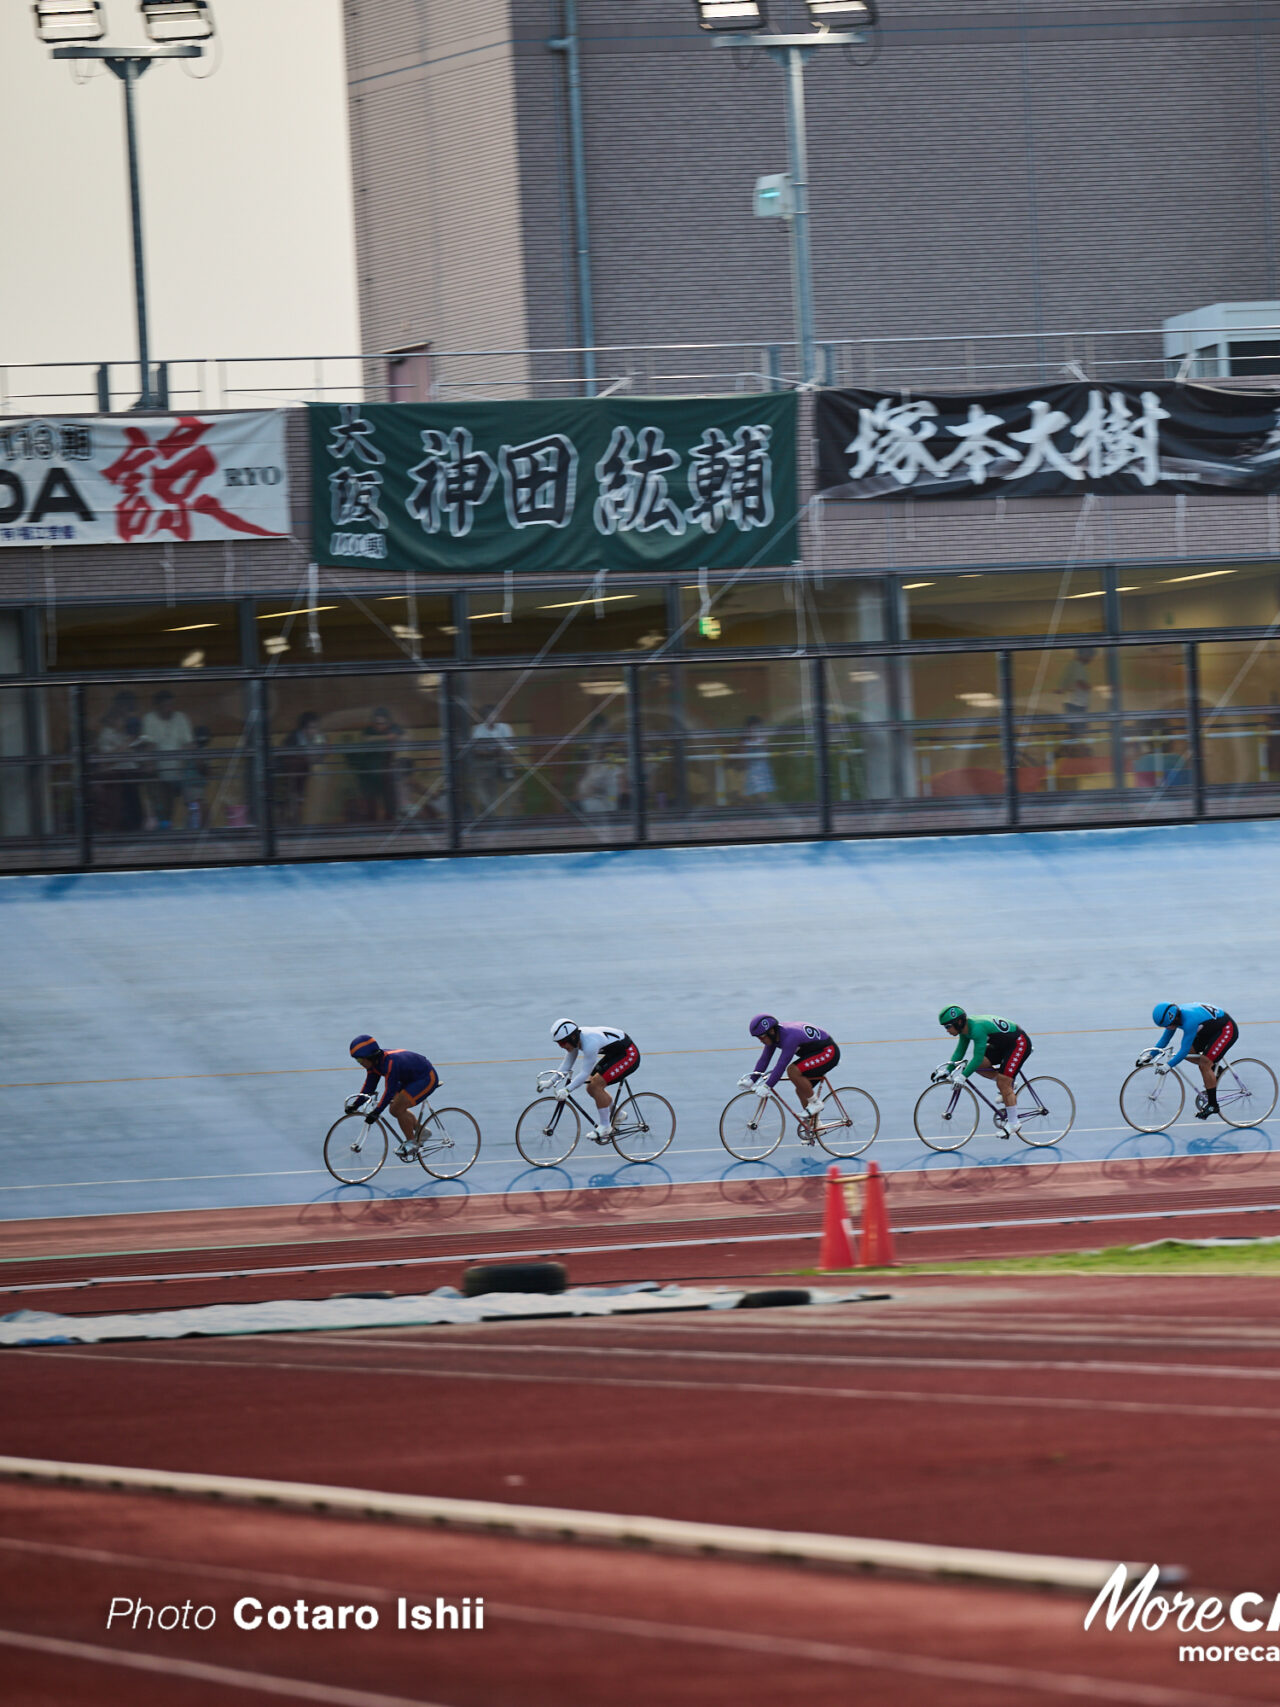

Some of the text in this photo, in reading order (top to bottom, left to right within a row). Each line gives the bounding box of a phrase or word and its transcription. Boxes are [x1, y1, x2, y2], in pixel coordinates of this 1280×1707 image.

[845, 390, 1171, 487] 塚本大樹
[326, 404, 389, 530] 大阪
[224, 465, 281, 487] RYO
[1200, 1003, 1219, 1020] 4
[761, 1018, 769, 1031] 9
[803, 1024, 821, 1040] 9
[992, 1017, 1011, 1034] 6
